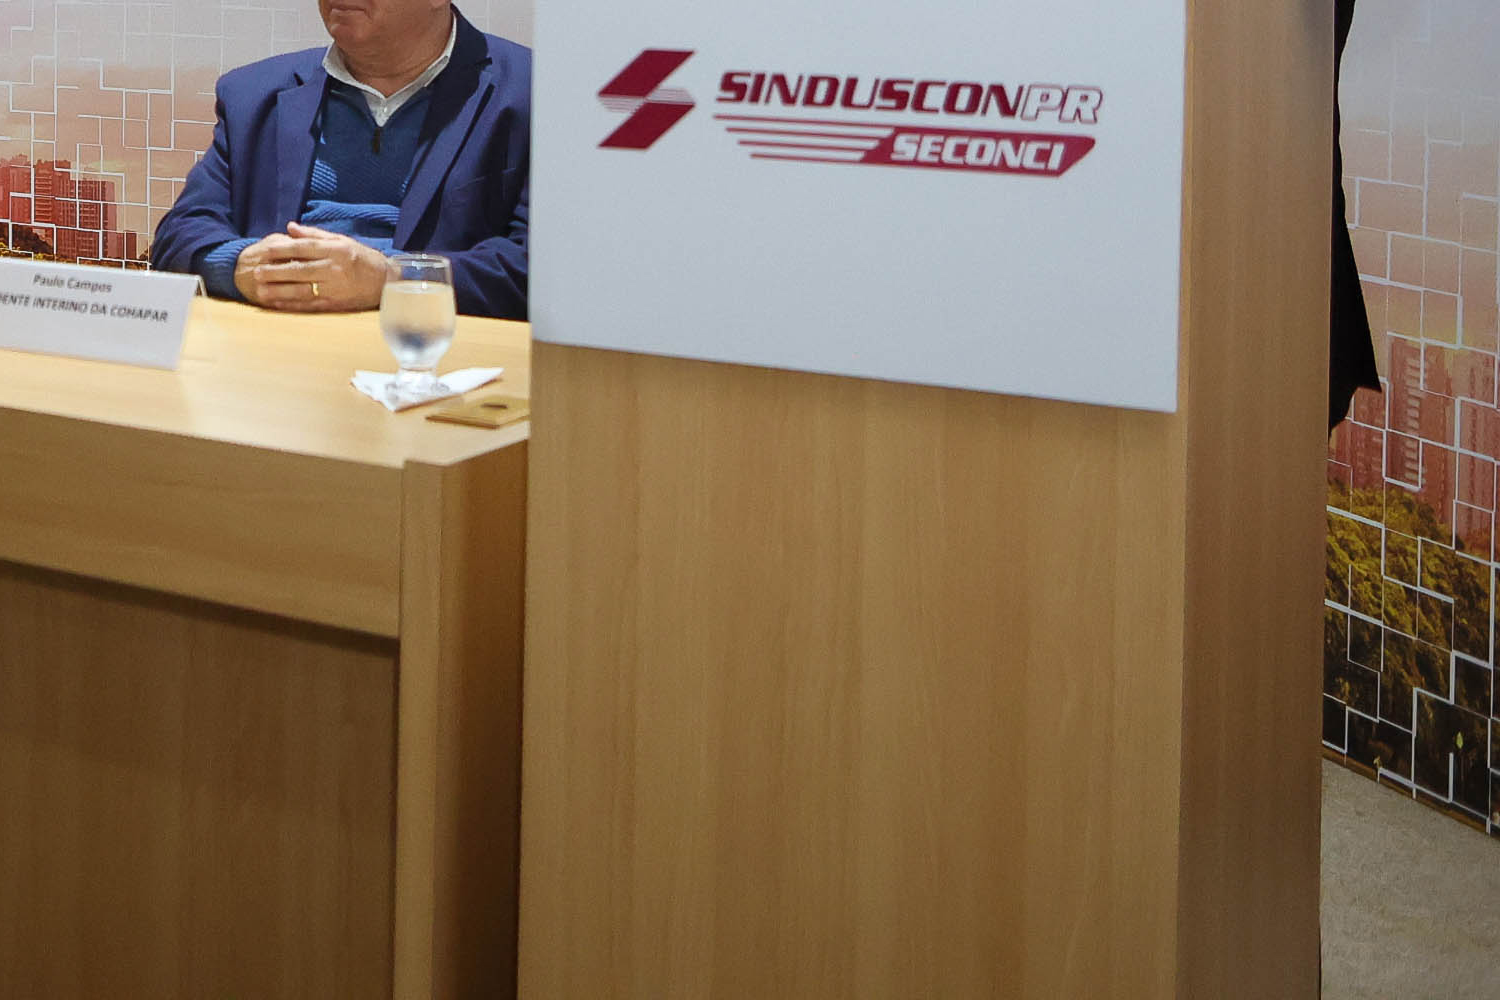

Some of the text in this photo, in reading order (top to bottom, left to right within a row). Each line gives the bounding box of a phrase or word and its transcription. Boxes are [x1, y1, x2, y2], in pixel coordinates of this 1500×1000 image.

[715, 70, 1103, 124] SINDUSCONPR
[890, 133, 1066, 171] SECONCI
[32, 274, 113, 294] Paulo Campos
[32, 297, 88, 315] INTERINO
[89, 303, 107, 316] DA
[110, 306, 169, 323] COHAPAR
